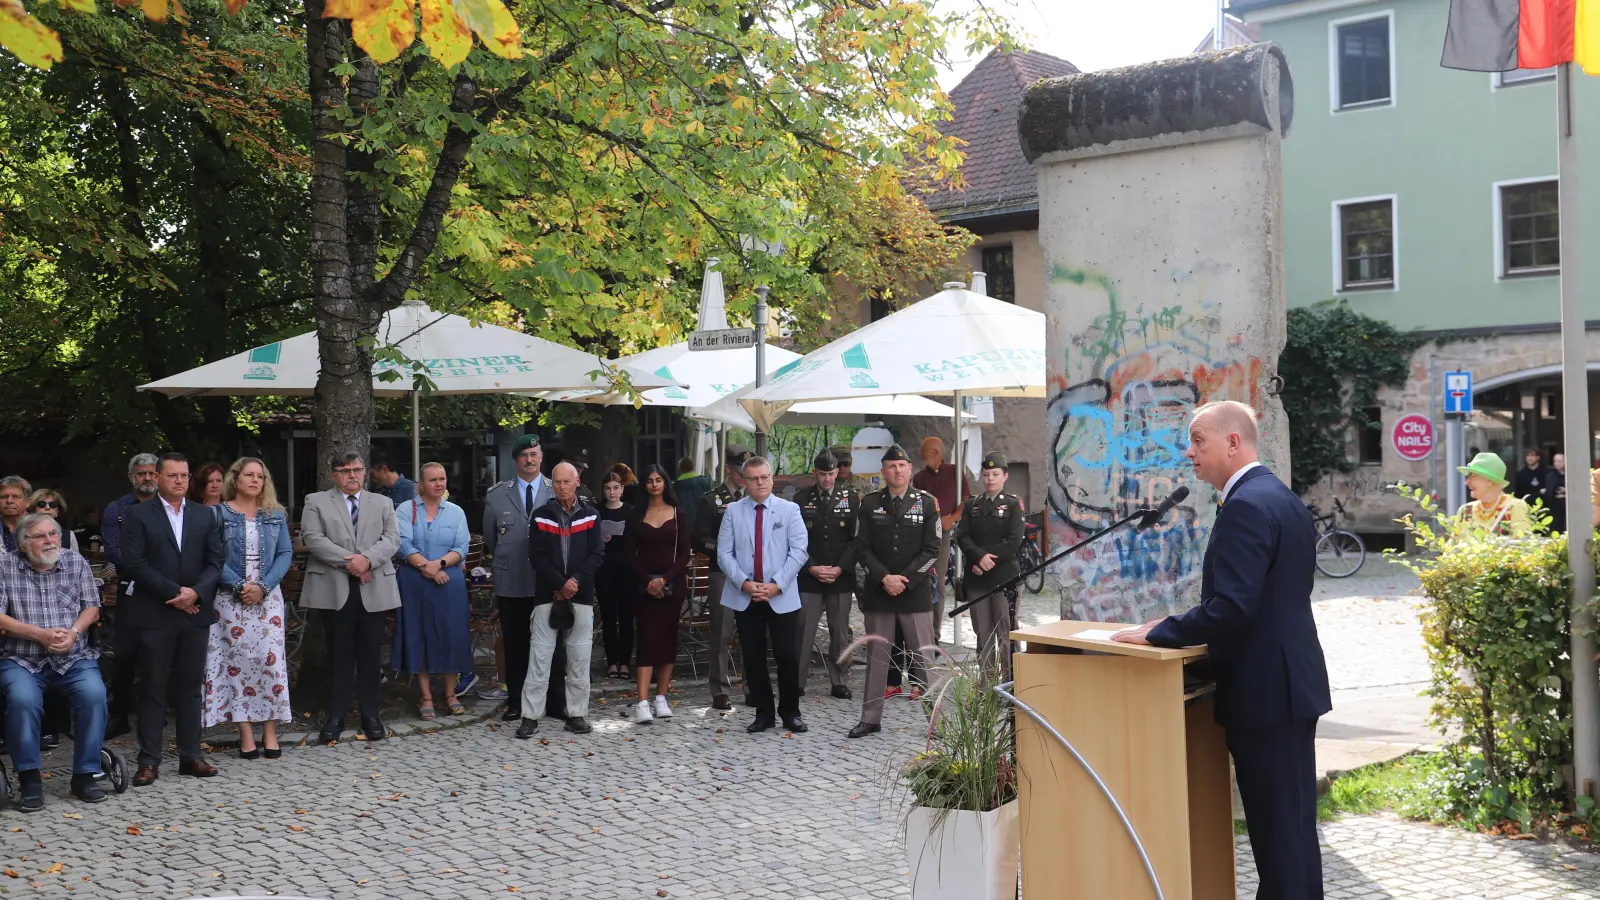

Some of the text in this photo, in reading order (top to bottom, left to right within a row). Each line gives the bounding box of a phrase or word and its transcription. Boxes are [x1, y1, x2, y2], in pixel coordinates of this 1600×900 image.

[692, 334, 750, 347] An der Riviera
[1402, 421, 1427, 436] City
[1397, 435, 1432, 447] NAILS
